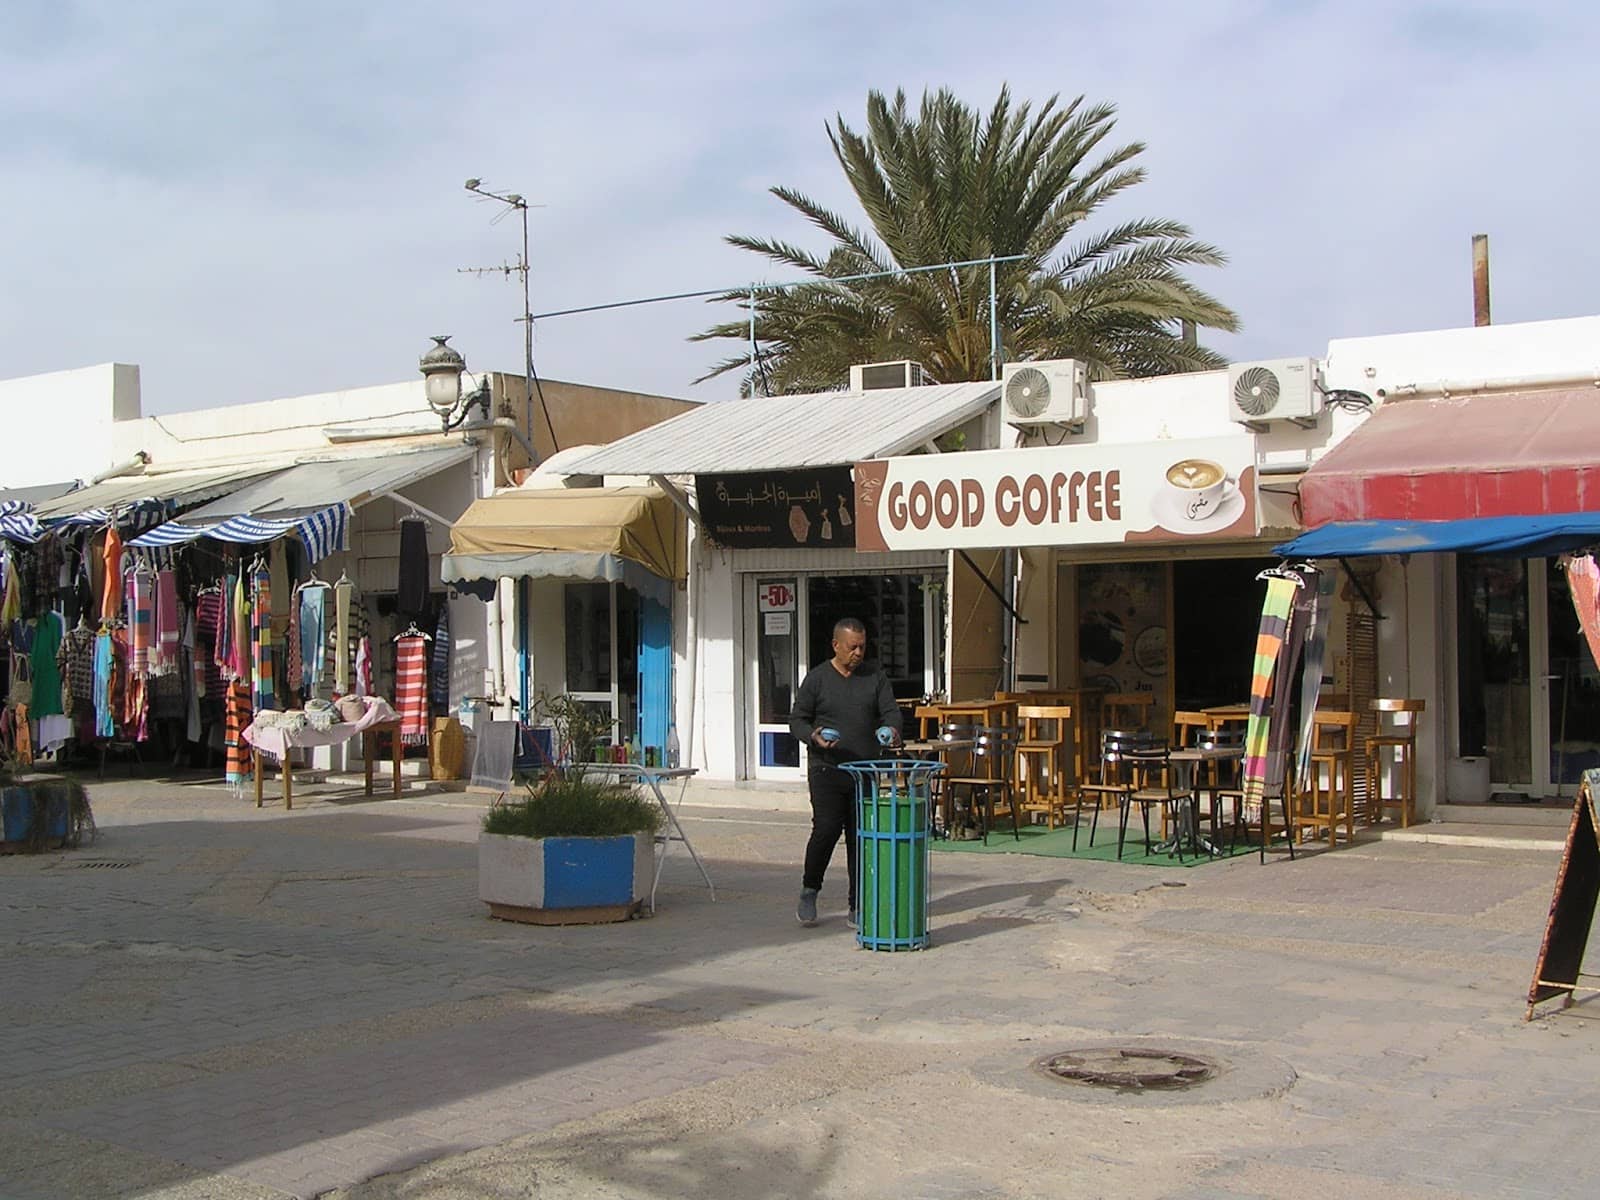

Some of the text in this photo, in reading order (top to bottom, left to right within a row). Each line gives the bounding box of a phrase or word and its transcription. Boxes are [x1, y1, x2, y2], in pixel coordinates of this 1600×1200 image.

[888, 469, 1121, 531] GOOD COFFEE
[761, 585, 794, 607] -50%
